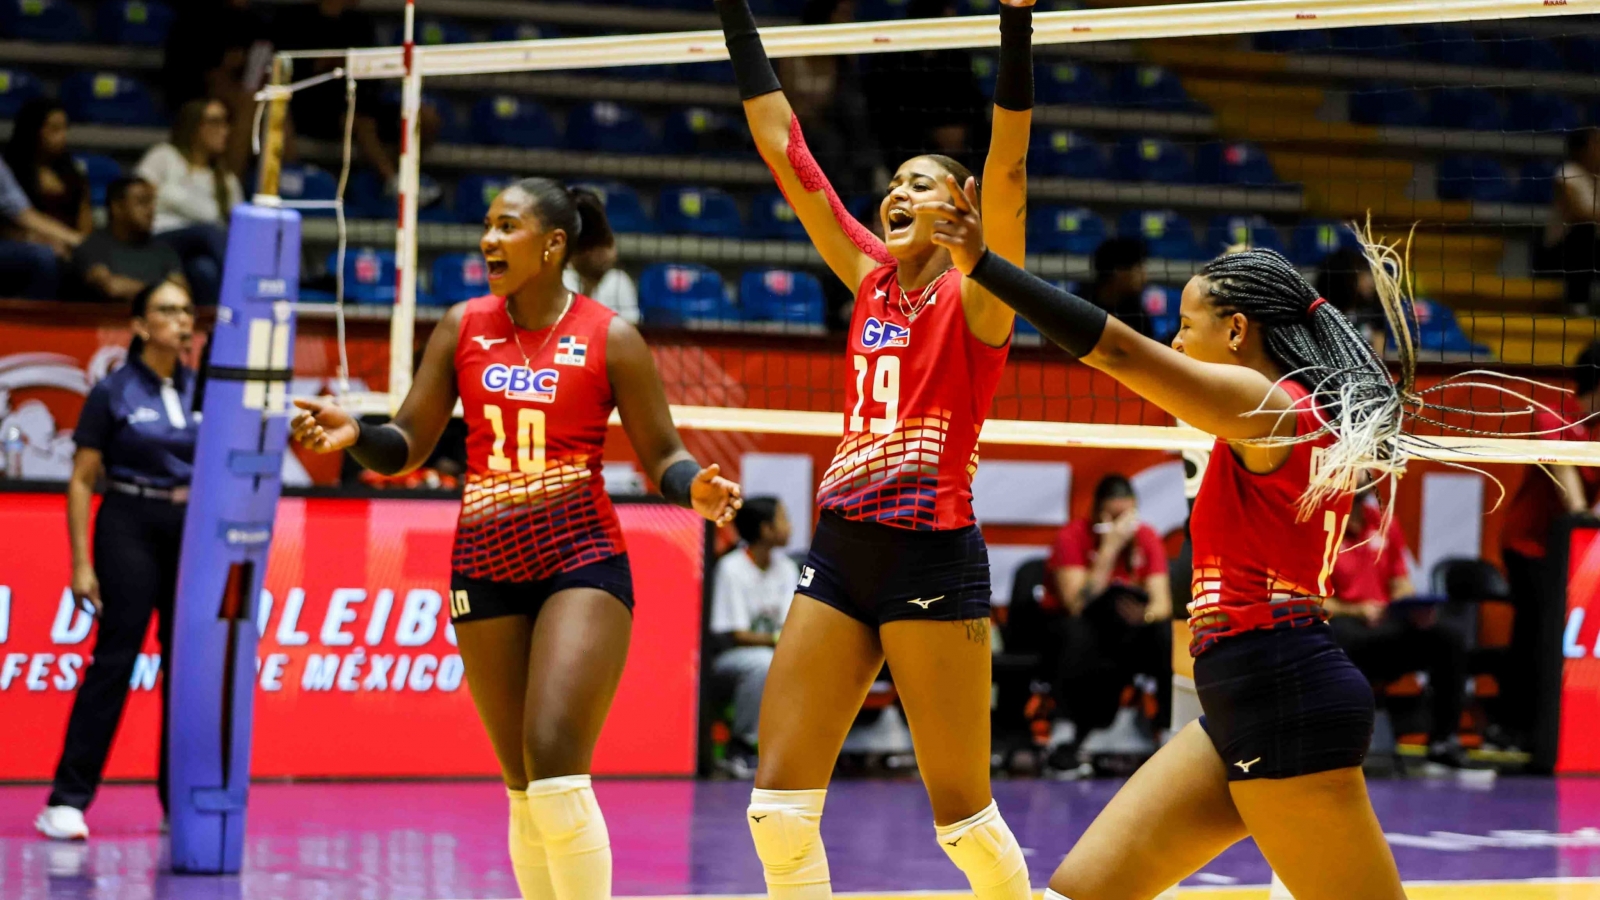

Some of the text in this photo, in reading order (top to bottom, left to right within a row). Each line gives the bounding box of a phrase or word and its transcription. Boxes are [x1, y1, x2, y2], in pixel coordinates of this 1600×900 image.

[482, 364, 559, 395] GBC
[849, 354, 900, 435] 19
[483, 404, 547, 474] 10
[301, 645, 465, 692] MÉXICO
